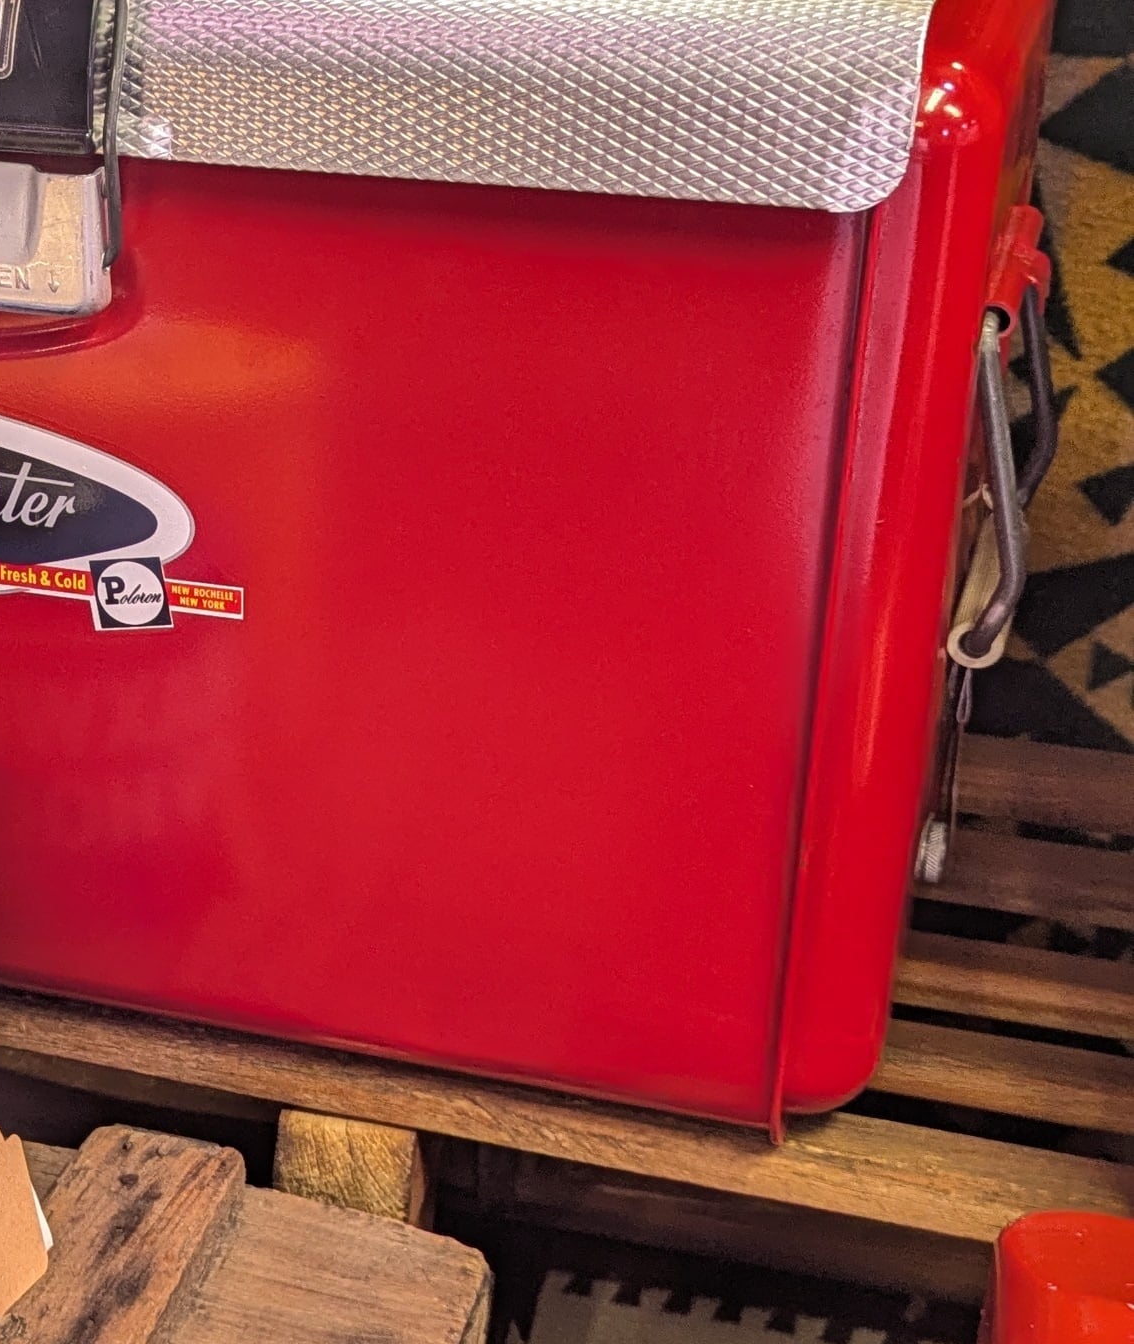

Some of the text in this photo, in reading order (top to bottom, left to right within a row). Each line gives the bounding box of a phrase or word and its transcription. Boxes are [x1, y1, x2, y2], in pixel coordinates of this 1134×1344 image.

[0, 564, 38, 586] Fresh
[40, 570, 51, 587] &
[54, 571, 87, 592] Cold
[101, 576, 162, 606] Poloron
[171, 585, 190, 597] NEW
[179, 596, 226, 611] NEW YORK
